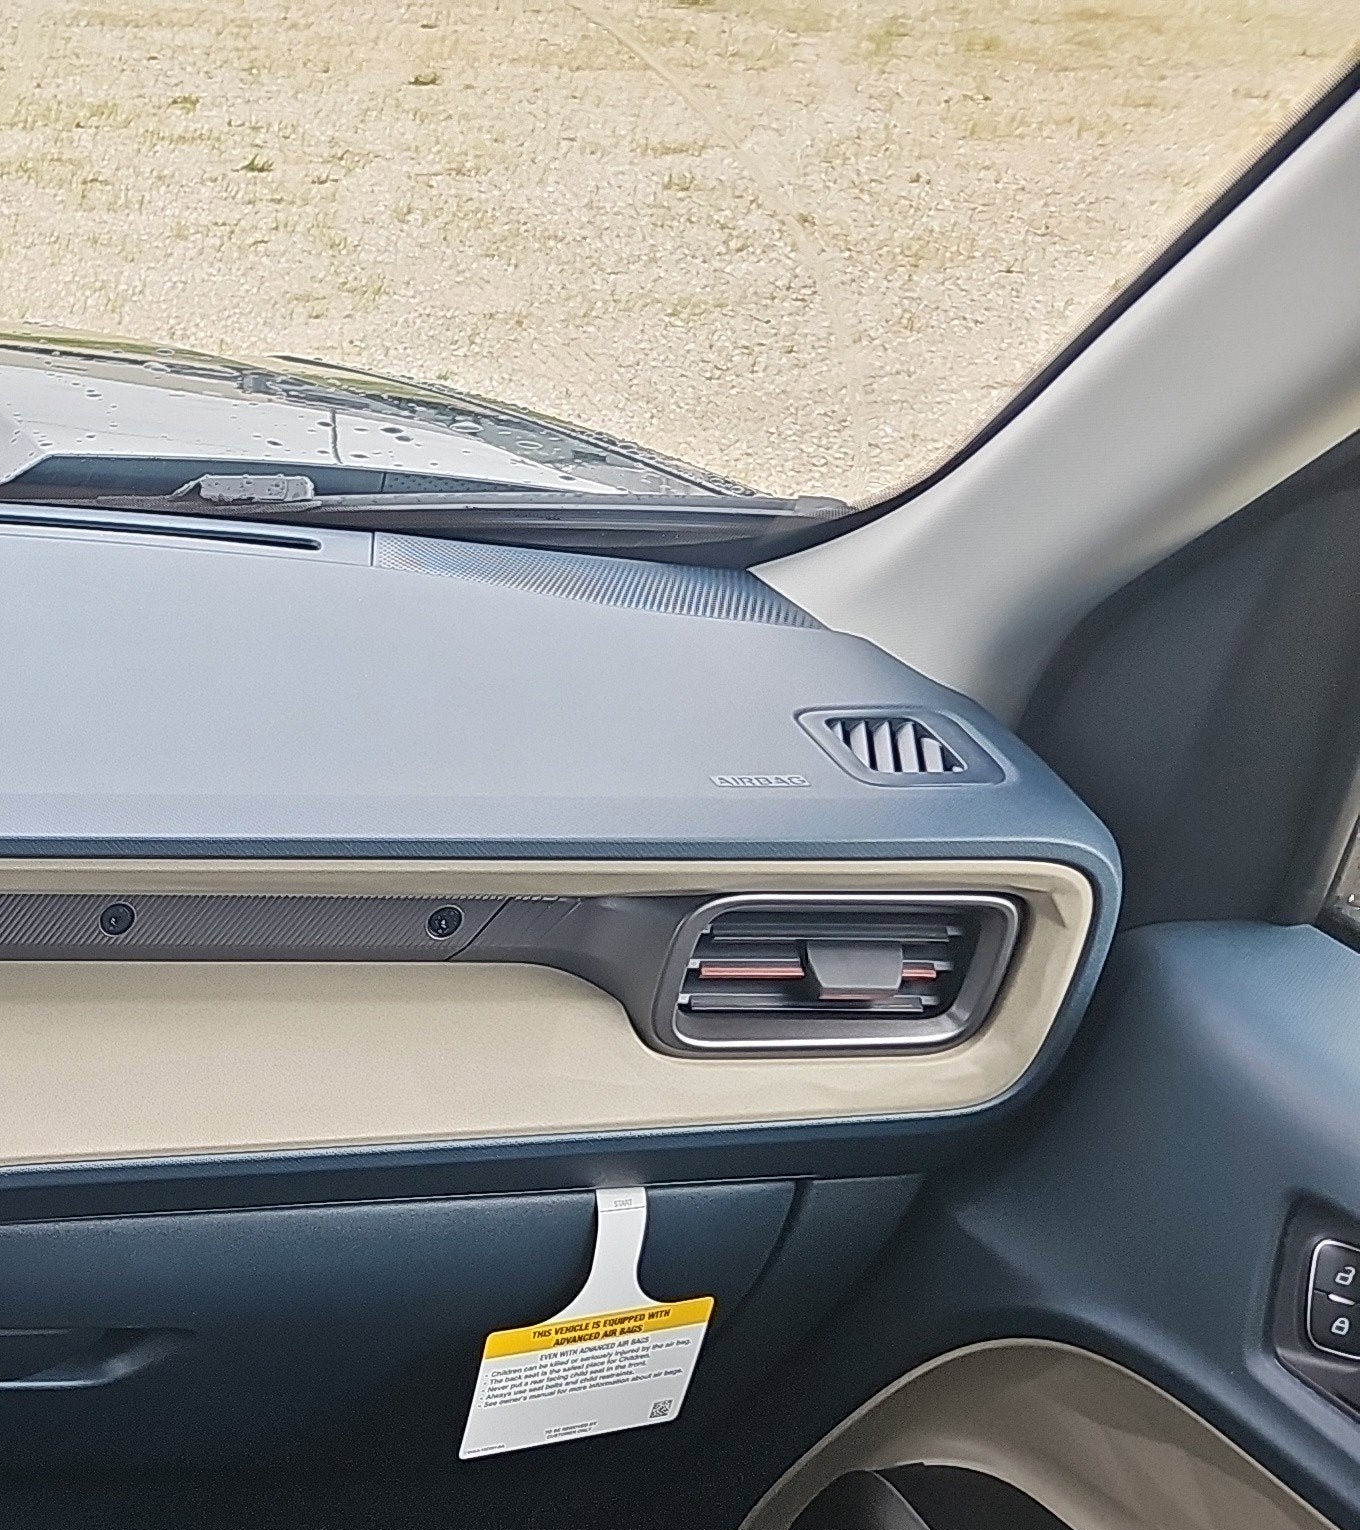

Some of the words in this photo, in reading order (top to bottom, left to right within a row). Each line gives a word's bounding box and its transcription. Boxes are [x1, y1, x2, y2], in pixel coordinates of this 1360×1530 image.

[532, 1329, 551, 1339] THIS
[555, 1322, 589, 1336] VEHICLE
[592, 1320, 600, 1329] IS
[603, 1313, 645, 1327] EQUIPPED
[648, 1309, 671, 1321] WITH
[553, 1332, 600, 1347] ADVANCED
[602, 1328, 617, 1339] AIR
[620, 1325, 643, 1336] BAGS
[540, 1351, 558, 1361] EVEN
[560, 1348, 578, 1357] WITH
[579, 1342, 615, 1355] ADVANCED
[491, 1368, 522, 1378] Children
[550, 1359, 569, 1367] killed
[641, 1345, 650, 1353] by
[490, 1378, 503, 1386] The
[505, 1374, 522, 1383] back
[486, 1391, 511, 1400] Always
[487, 1384, 509, 1393] Never
[483, 1400, 498, 1408] See
